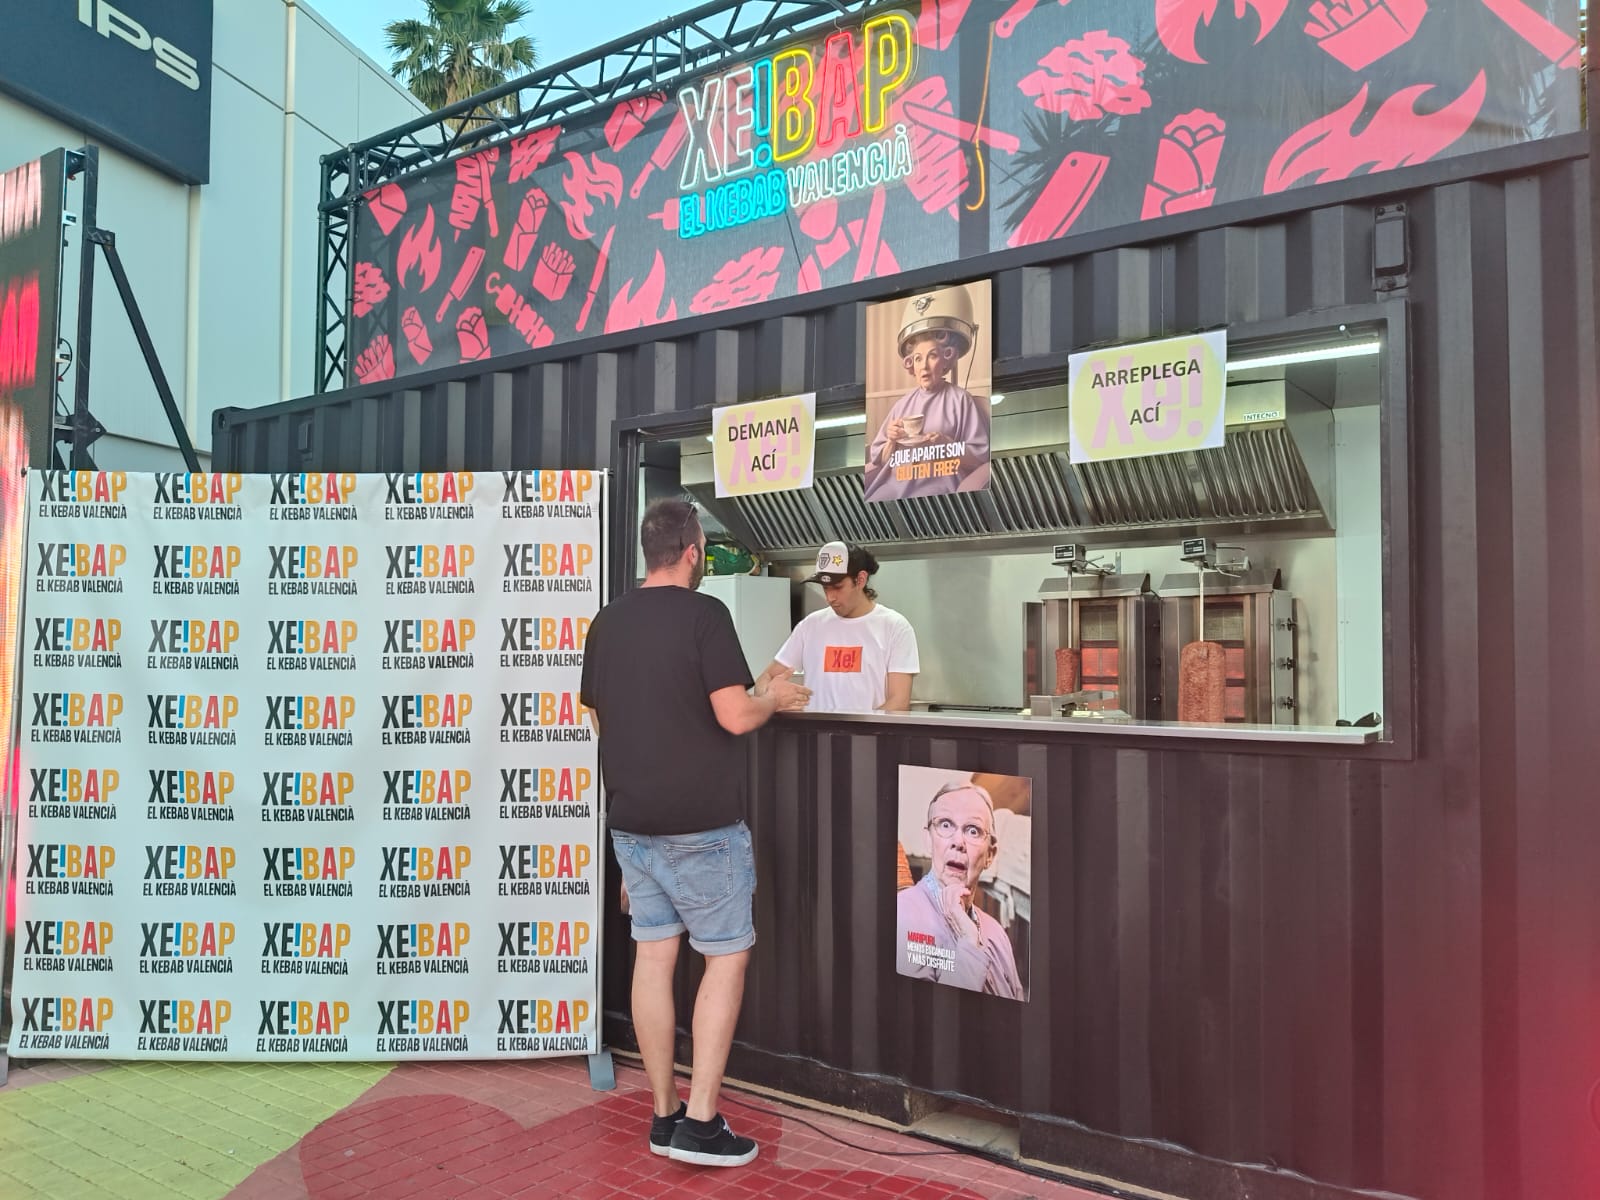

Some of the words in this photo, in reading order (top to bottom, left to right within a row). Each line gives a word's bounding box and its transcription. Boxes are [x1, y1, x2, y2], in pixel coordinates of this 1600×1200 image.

[679, 15, 912, 190] XE!BAP
[679, 192, 705, 239] EL
[705, 168, 787, 232] KEBAB
[1091, 358, 1201, 389] ARREPLEGA
[728, 416, 800, 442] DEMANA
[1129, 401, 1161, 425] ACÍ
[751, 448, 776, 473] ACÍ
[889, 448, 911, 469] ¿QUE
[911, 444, 946, 463] APARTE
[946, 441, 966, 458] SON
[896, 463, 931, 482] GLUTEN
[933, 458, 961, 478] FREE?
[40, 470, 127, 503] XE!BAP
[154, 471, 242, 505] XE!BAP
[270, 472, 357, 505] XE!BAP
[386, 472, 473, 505] XE!BAP
[503, 470, 592, 503] XE!BAP
[39, 505, 50, 518] EL
[51, 505, 80, 518] KEBAB
[81, 504, 127, 519] VALENCIÀ
[270, 508, 280, 521] EL
[281, 507, 311, 521] KEBAB
[312, 506, 357, 521] VALENCIÀ
[503, 506, 514, 519] EL
[515, 505, 544, 519] KEBAB
[545, 504, 591, 519] VALENCIÀ
[37, 543, 126, 577] XE!BAP
[154, 545, 240, 578] XE!BAP
[269, 546, 358, 579] XE!BAP
[386, 545, 474, 579] XE!BAP
[504, 544, 592, 577] XE!BAP
[37, 579, 47, 593] EL
[48, 579, 79, 593] KEBAB
[80, 578, 122, 593] VALENCIÀ
[153, 581, 164, 595] EL
[165, 581, 194, 595] KEBAB
[195, 580, 239, 595] VALENCIÀ
[386, 582, 396, 595] EL
[397, 581, 427, 595] KEBAB
[428, 580, 474, 594] VALENCIÀ
[503, 580, 513, 593] EL
[514, 579, 545, 593] KEBAB
[546, 578, 592, 593] VALENCIÀ
[34, 618, 121, 652] XE!BAP
[149, 620, 239, 654] XE!BAP
[268, 620, 357, 654] XE!BAP
[383, 619, 475, 653] XE!BAP
[148, 656, 159, 669] EL
[160, 656, 192, 670] KEBAB
[193, 655, 239, 670] VALENCIÀ
[267, 657, 277, 671] EL
[278, 657, 309, 671] KEBAB
[310, 656, 356, 671] VALENCIÀ
[383, 657, 393, 670] EL
[394, 656, 425, 670] KEBAB
[426, 654, 473, 669] VALENCIÀ
[832, 650, 856, 669] Xe!
[32, 693, 123, 727] XE!BAP
[147, 695, 238, 729] XE!BAP
[265, 696, 355, 730] XE!BAP
[382, 694, 472, 728] XE!BAP
[31, 729, 42, 743] EL
[43, 729, 73, 743] KEBAB
[74, 728, 121, 744] VALENCIÀ
[265, 733, 275, 746] EL
[276, 733, 306, 746] KEBAB
[307, 732, 352, 746] VALENCIÀ
[501, 730, 512, 743] EL
[513, 729, 543, 743] KEBAB
[544, 728, 590, 742] VALENCIÀ
[29, 768, 119, 803] XE!BAP
[148, 770, 234, 804] XE!BAP
[262, 772, 354, 806] XE!BAP
[383, 770, 471, 804] XE!BAP
[500, 768, 590, 802] XE!BAP
[29, 805, 40, 819] EL
[41, 805, 70, 819] KEBAB
[71, 804, 116, 820] VALENCIÀ
[148, 806, 159, 820] EL
[160, 806, 189, 820] KEBAB
[190, 805, 234, 822] VALENCIÀ
[383, 807, 393, 821] EL
[394, 807, 424, 821] KEBAB
[425, 806, 470, 821] VALENCIÀ
[500, 806, 511, 819] EL
[512, 805, 542, 819] KEBAB
[543, 804, 590, 819] VALENCIÀ
[27, 844, 115, 879] XE!BAP
[144, 845, 235, 879] XE!BAP
[263, 847, 355, 881] XE!BAP
[380, 846, 471, 881] XE!BAP
[499, 844, 590, 879] XE!BAP
[143, 883, 155, 897] EL
[156, 883, 188, 897] KEBAB
[189, 882, 236, 897] VALENCIÀ
[264, 884, 275, 897] EL
[276, 883, 307, 897] KEBAB
[308, 882, 352, 897] VALENCIÀ
[499, 883, 510, 896] EL
[511, 882, 542, 896] KEBAB
[543, 881, 590, 896] VALENCIÀ
[24, 921, 113, 955] XE!BAP
[140, 922, 235, 957] XE!BAP
[262, 922, 350, 958] XE!BAP
[377, 922, 470, 958] XE!BAP
[498, 922, 589, 956] XE!BAP
[24, 958, 35, 971] EL
[36, 958, 66, 972] KEBAB
[67, 957, 113, 972] VALENCIÀ
[262, 960, 272, 974] EL
[273, 960, 302, 975] KEBAB
[303, 959, 348, 976] VALENCIÀ
[377, 962, 388, 976] EL
[389, 960, 421, 975] KEBAB
[422, 959, 468, 974] VALENCIÀ
[498, 960, 510, 973] EL
[511, 959, 540, 974] KEBAB
[541, 958, 588, 974] VALENCIÀ
[926, 956, 956, 972] DISFRUTE
[22, 997, 113, 1032] XE!BAP
[139, 1000, 231, 1034] XE!BAP
[258, 1000, 349, 1035] XE!BAP
[377, 1000, 469, 1034] XE!BAP
[498, 1000, 588, 1034] XE!BAP
[19, 1035, 30, 1049] EL
[31, 1035, 62, 1049] KEBAB
[63, 1034, 109, 1050] VALENCIÀ
[138, 1037, 148, 1051] EL
[149, 1037, 180, 1052] KEBAB
[181, 1036, 227, 1052] VALENCIÀ
[377, 1038, 388, 1053] EL
[389, 1038, 420, 1053] KEBAB
[421, 1036, 468, 1052] VALENCIÀ
[498, 1037, 508, 1052] EL
[509, 1037, 541, 1052] KEBAB
[542, 1036, 589, 1052] VALENCIÀ
